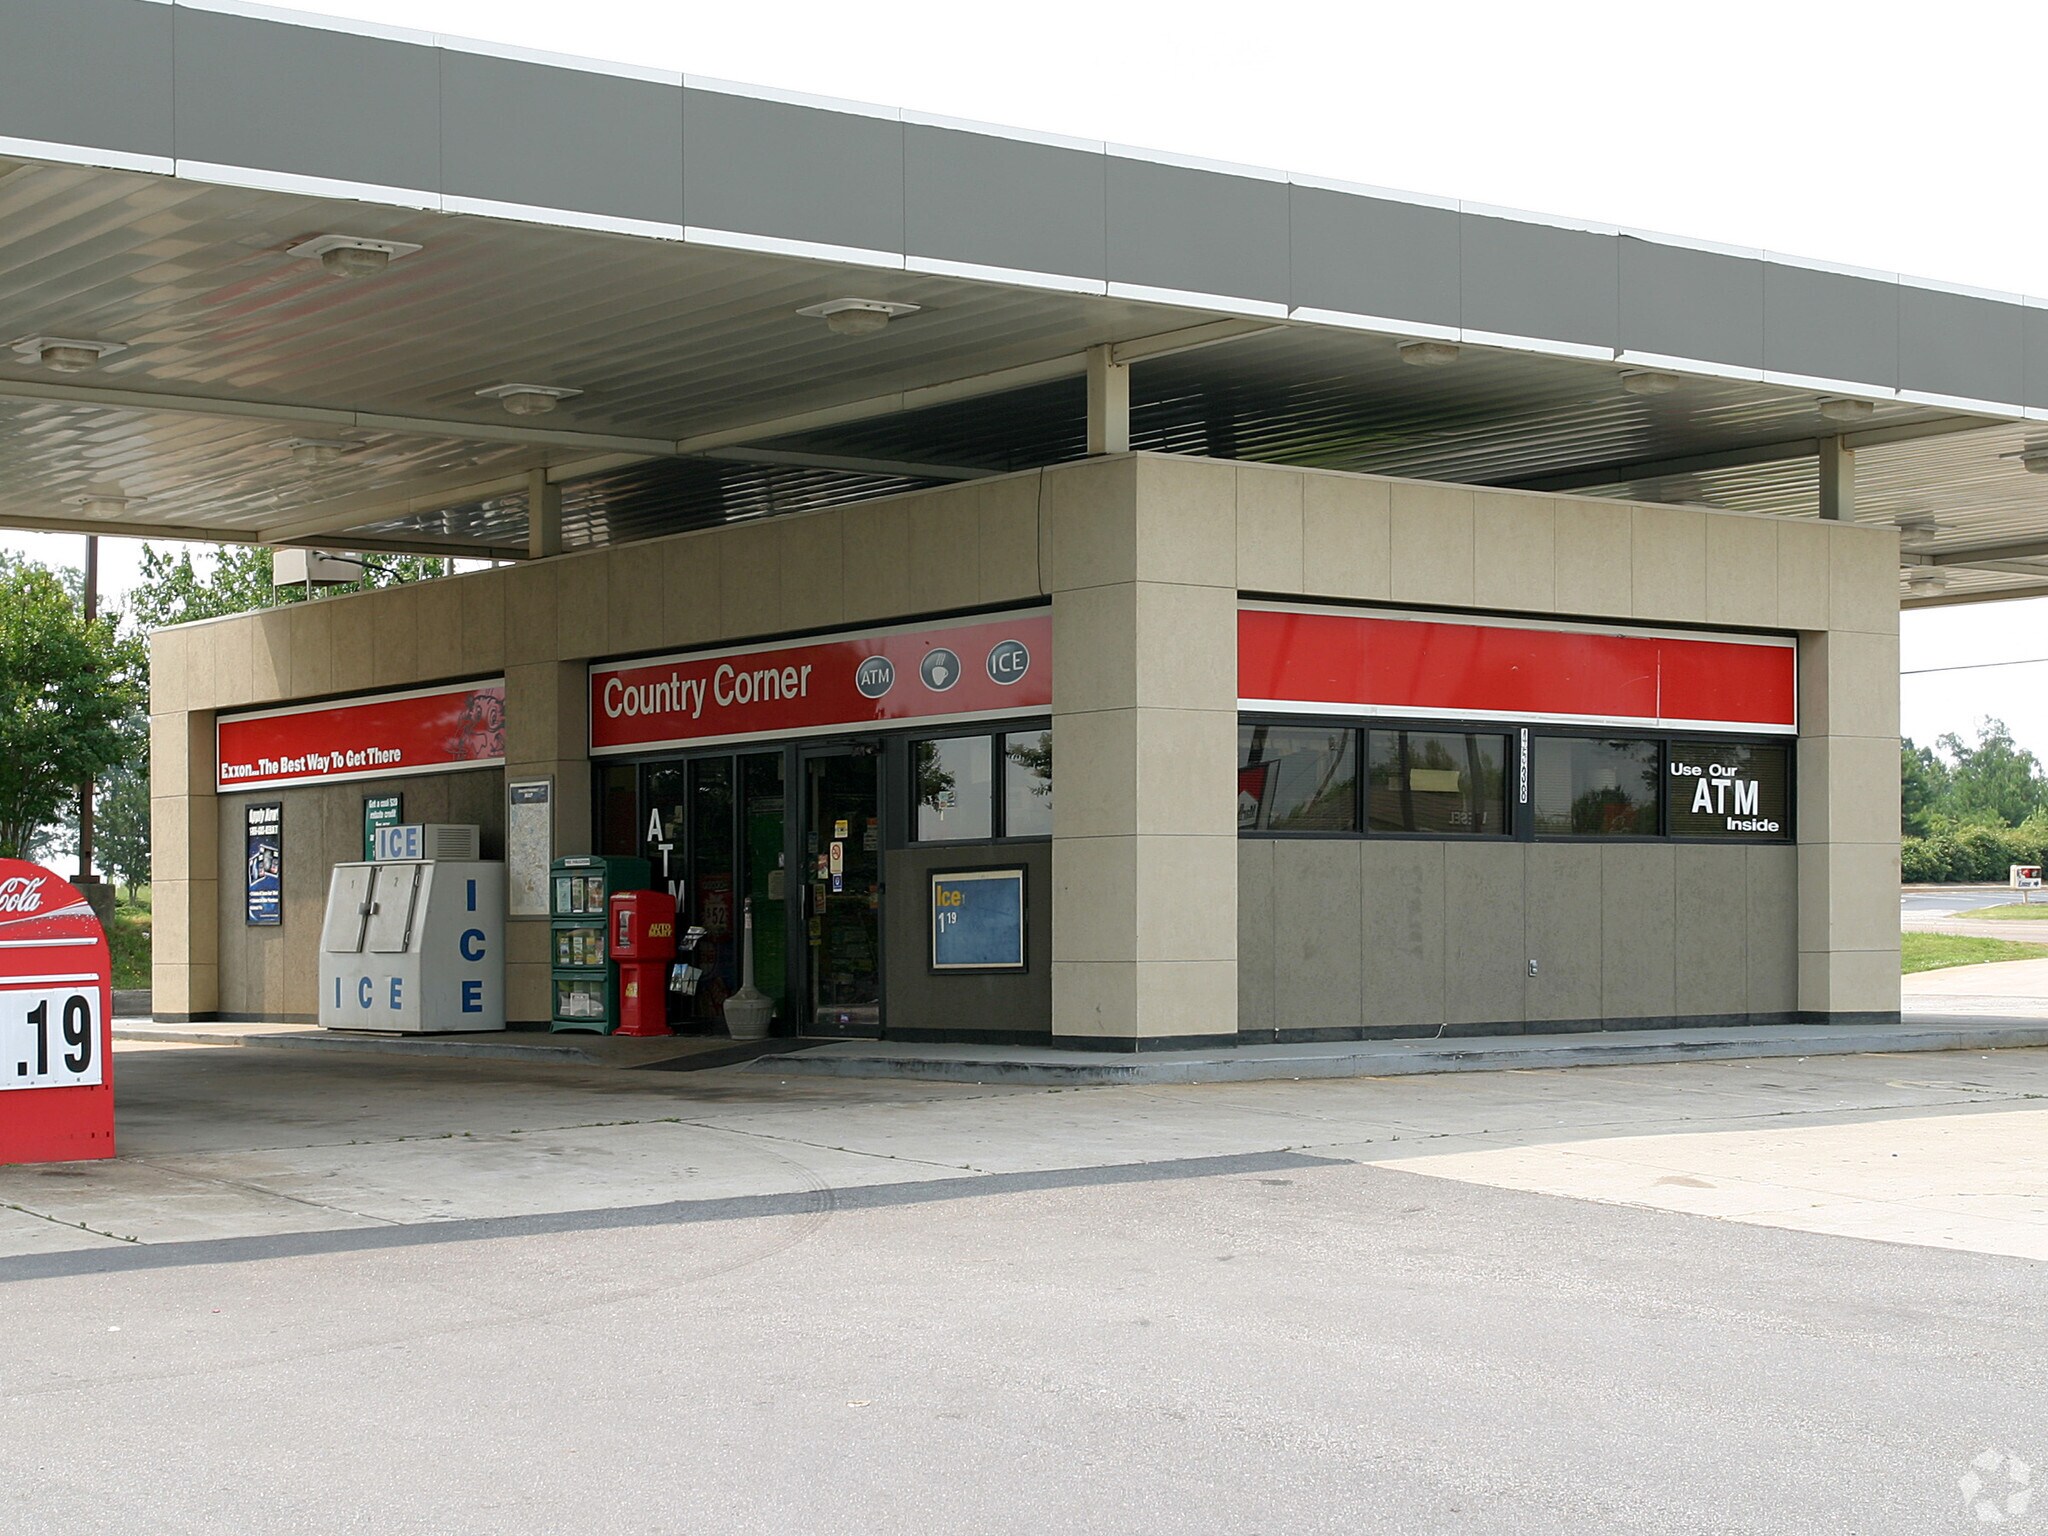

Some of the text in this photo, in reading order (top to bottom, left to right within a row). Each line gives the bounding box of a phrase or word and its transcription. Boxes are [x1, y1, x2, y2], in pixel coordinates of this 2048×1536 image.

[861, 668, 890, 686] ATM
[992, 651, 1024, 675] ICE
[604, 662, 812, 719] Country Corner
[280, 755, 306, 773] Best
[306, 752, 331, 774] Way
[331, 750, 345, 768] To
[345, 749, 367, 767] Get
[367, 746, 402, 765] There
[1671, 762, 1738, 777] Use Our
[1691, 777, 1758, 815] ATM
[1726, 816, 1779, 832] Inside
[380, 828, 418, 857] ICE
[647, 808, 685, 912] ATM
[936, 885, 961, 907] Ice
[650, 923, 671, 933] AUTO
[460, 879, 486, 1013] ICE
[335, 976, 402, 1010] ICE
[17, 994, 92, 1075] .19
